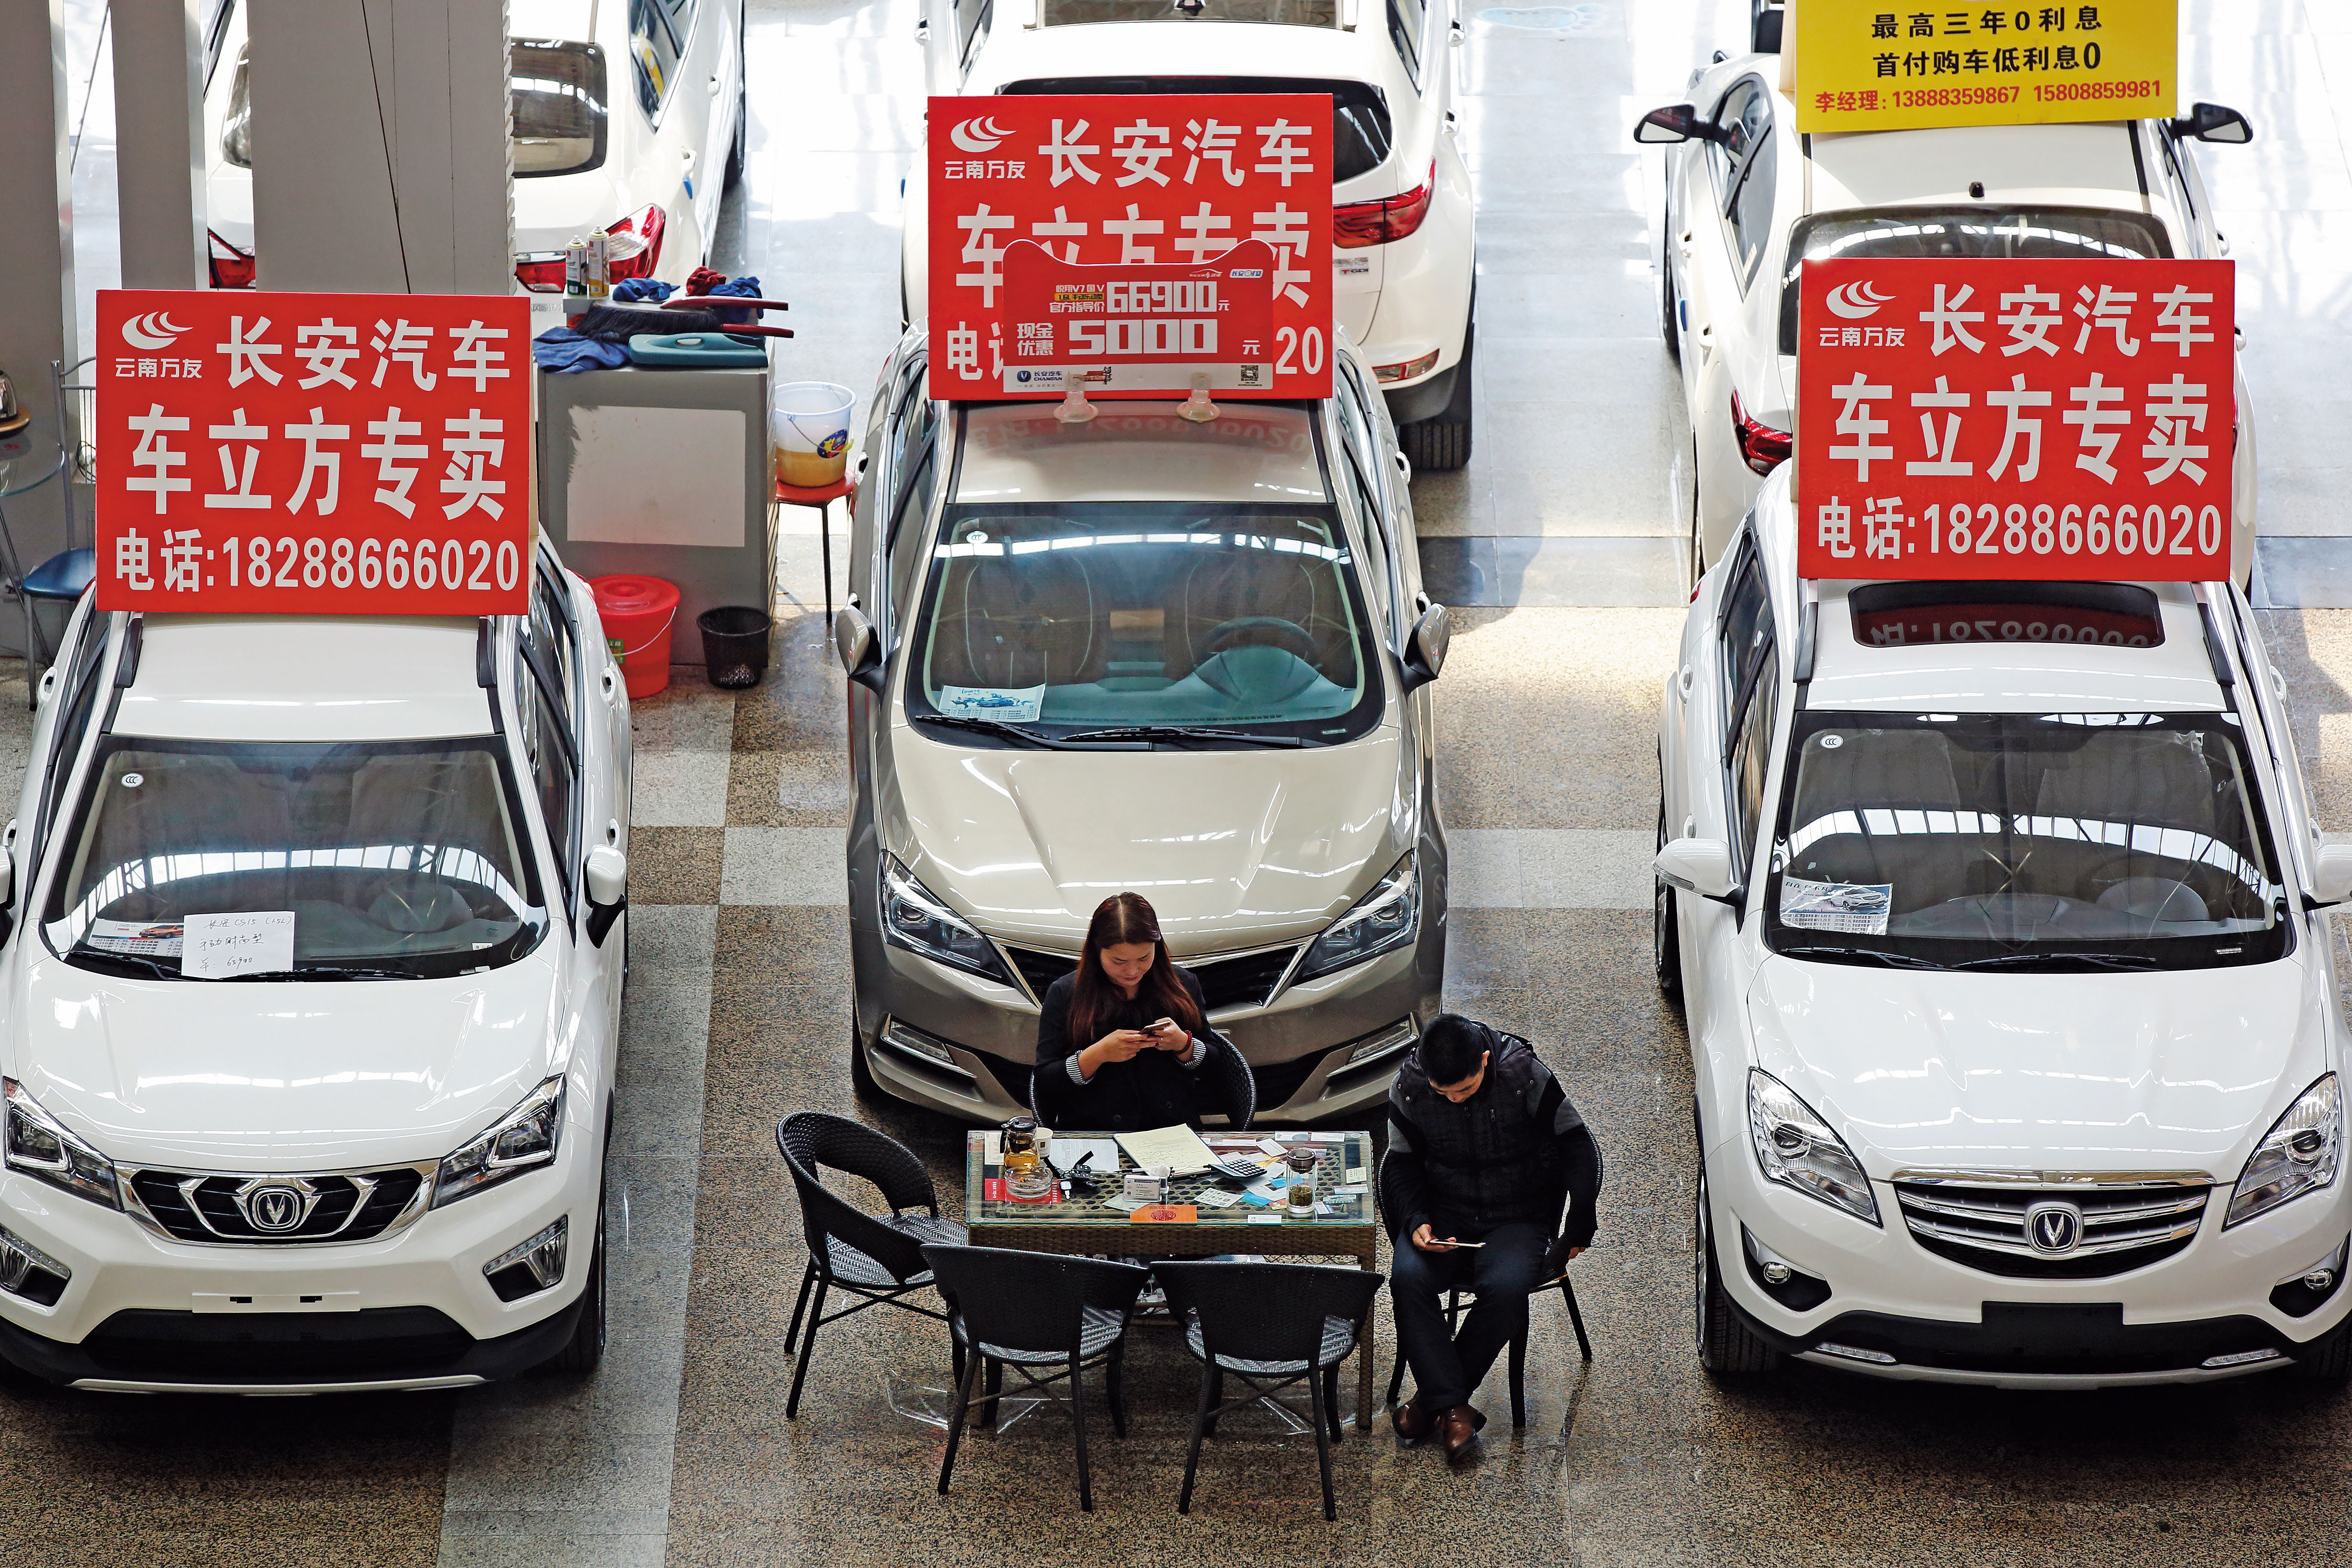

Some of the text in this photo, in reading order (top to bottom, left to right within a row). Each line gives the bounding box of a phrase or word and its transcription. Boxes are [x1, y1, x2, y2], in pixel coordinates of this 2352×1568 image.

[1872, 6, 2102, 39] 最高三年0利息
[1873, 42, 2101, 77] 首付购车低利息0
[2034, 80, 2160, 102] 15808859981
[945, 160, 1026, 179] 云南万友
[1039, 118, 1314, 188] 长安汽车
[1049, 301, 1105, 313] 官方指导价
[1919, 283, 2214, 357] 长安汽车
[1017, 323, 1054, 339] 现金
[1017, 339, 1054, 356] 优惠
[1069, 319, 1261, 355] 5000 元
[1819, 327, 1905, 347] 云南万友
[115, 358, 202, 378] 云南万友
[216, 315, 510, 392] 长安汽车
[1829, 371, 2209, 486] 车立方专卖
[126, 403, 506, 521] 车立方专卖
[1818, 496, 2222, 561] 电话:18288666020
[116, 527, 519, 592] 电话:18288666020
[234, 918, 258, 927] CS15
